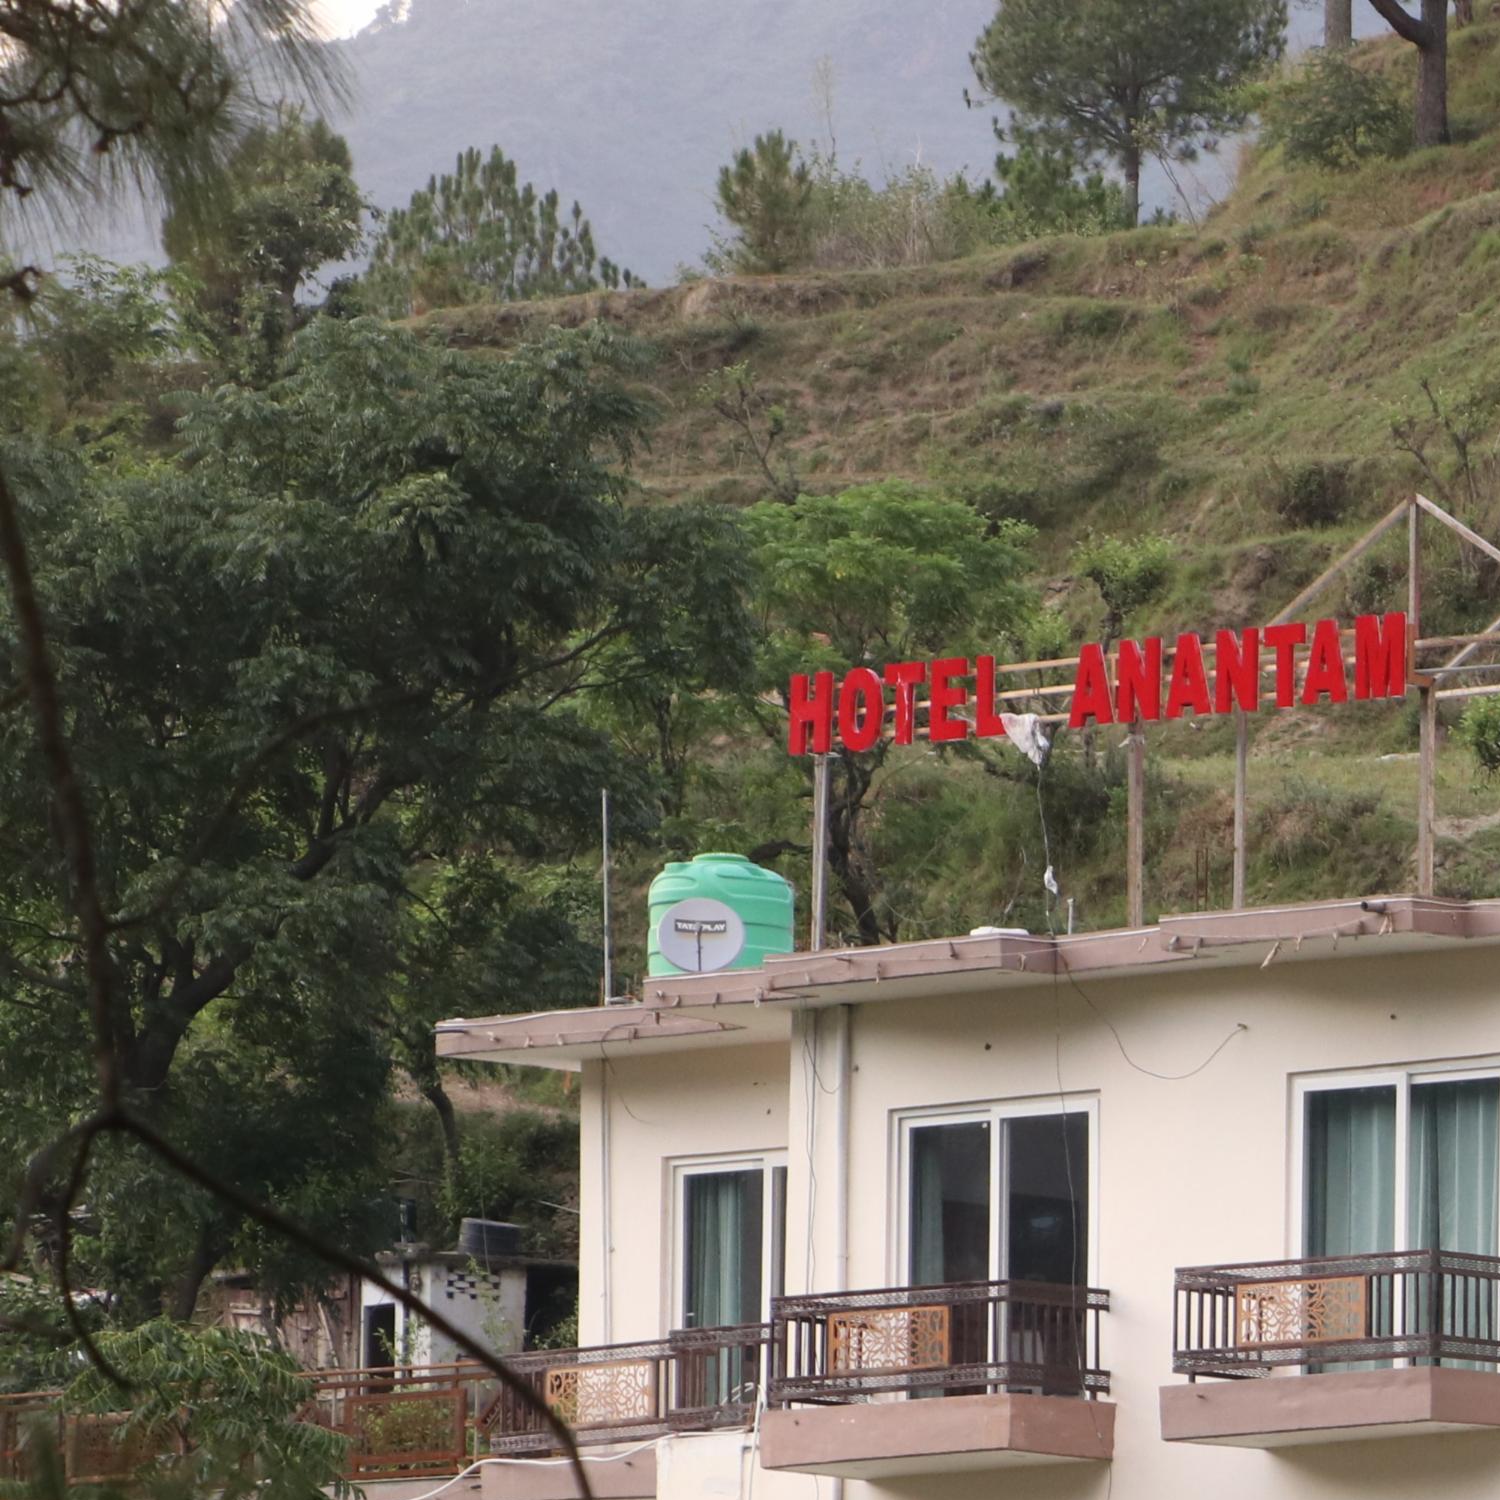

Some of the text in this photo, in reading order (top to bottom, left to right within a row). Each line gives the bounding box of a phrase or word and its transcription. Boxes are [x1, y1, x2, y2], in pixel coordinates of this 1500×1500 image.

[788, 611, 1407, 756] HOTEL ANANTAM
[701, 923, 726, 932] PLAY
